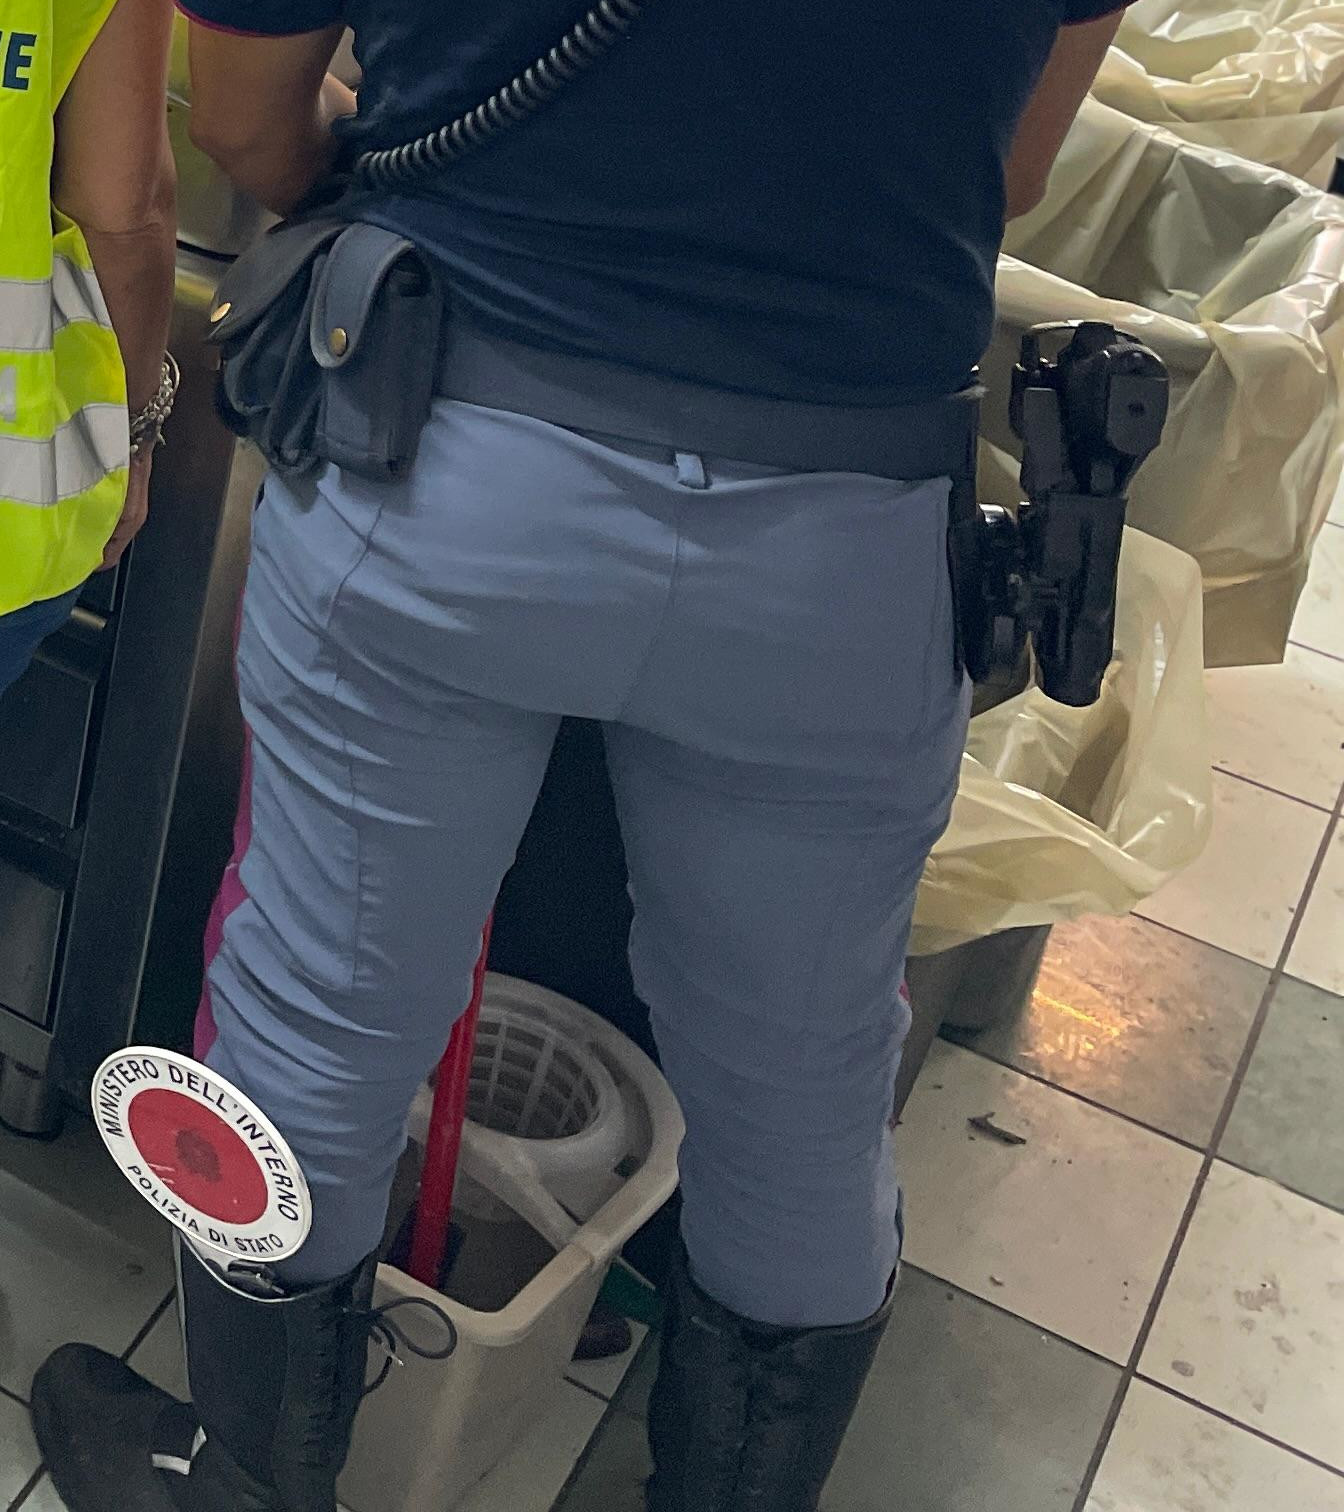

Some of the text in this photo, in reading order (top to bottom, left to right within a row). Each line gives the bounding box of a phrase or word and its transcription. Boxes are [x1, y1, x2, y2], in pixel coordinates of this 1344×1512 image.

[99, 1059, 159, 1138] MINISTERO
[127, 1165, 284, 1254] POLIZIA DI STATO
